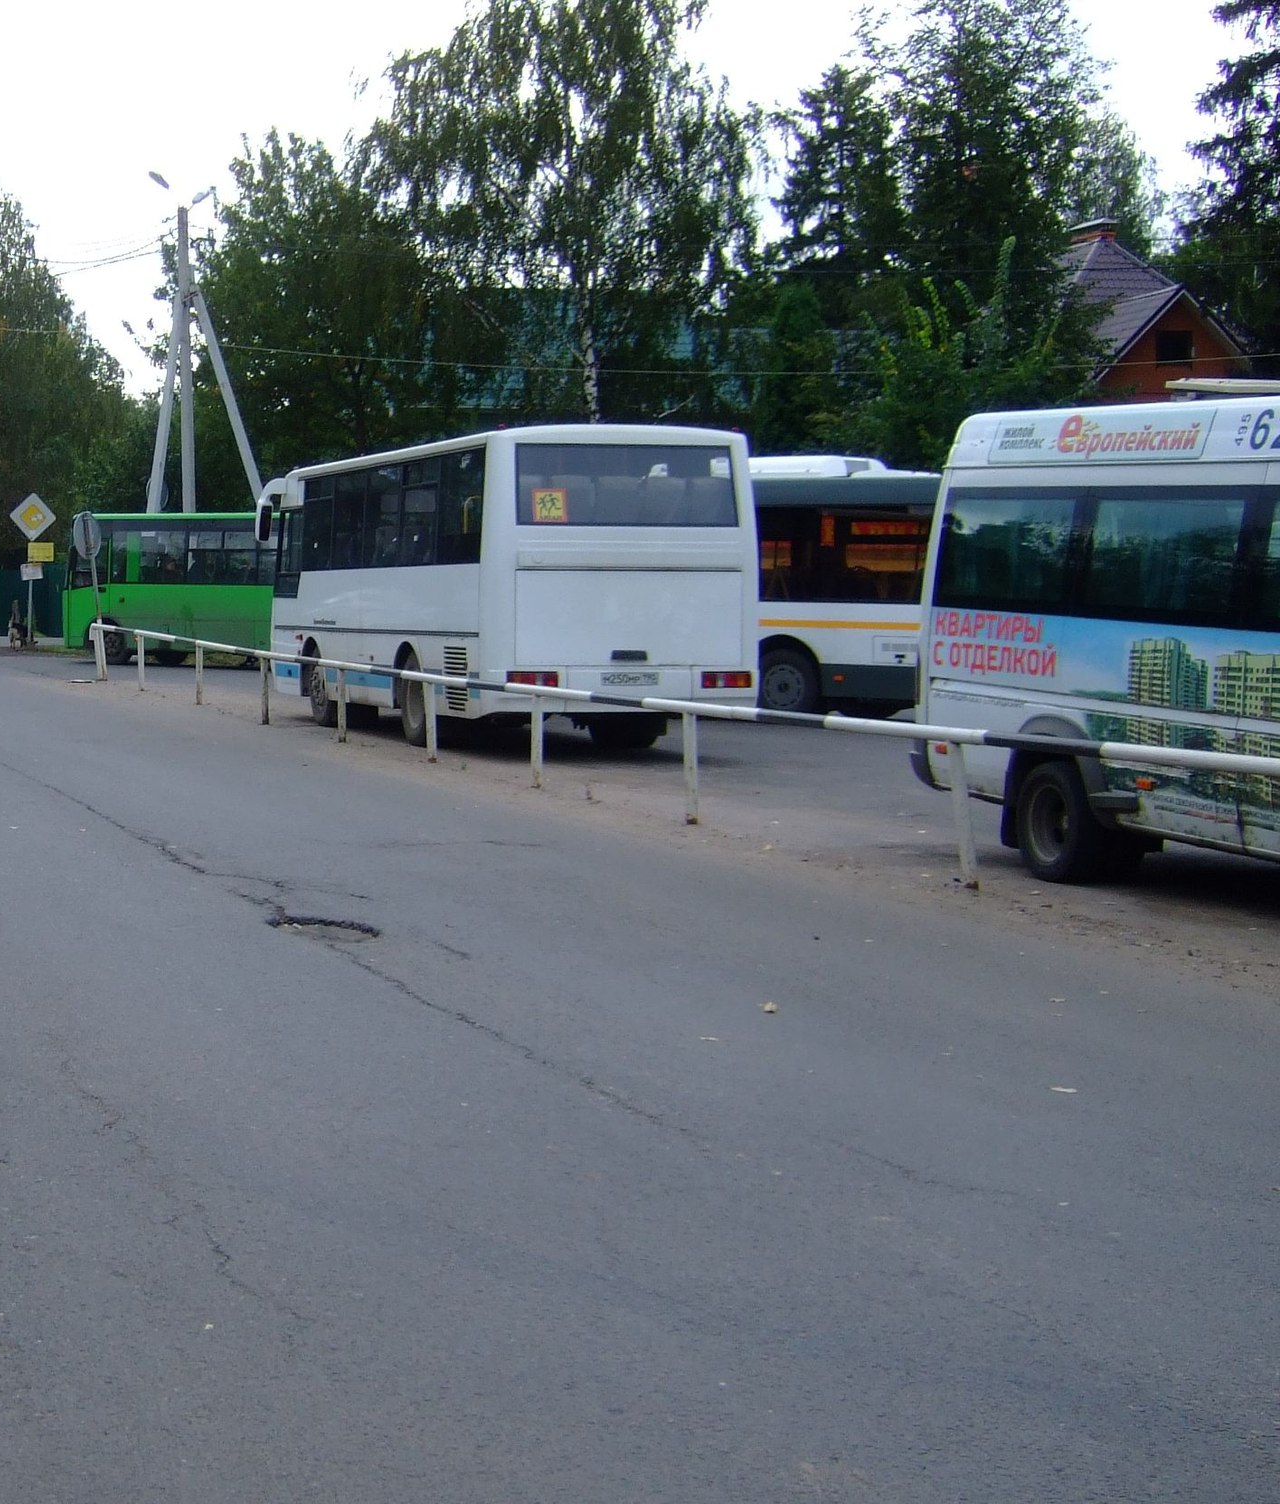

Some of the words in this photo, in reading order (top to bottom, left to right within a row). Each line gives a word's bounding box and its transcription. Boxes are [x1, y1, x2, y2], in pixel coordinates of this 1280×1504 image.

[935, 611, 1044, 643] КВАРТИРЫ
[933, 640, 944, 666] С
[950, 642, 1057, 677] ОТДЕЛКОЙ
